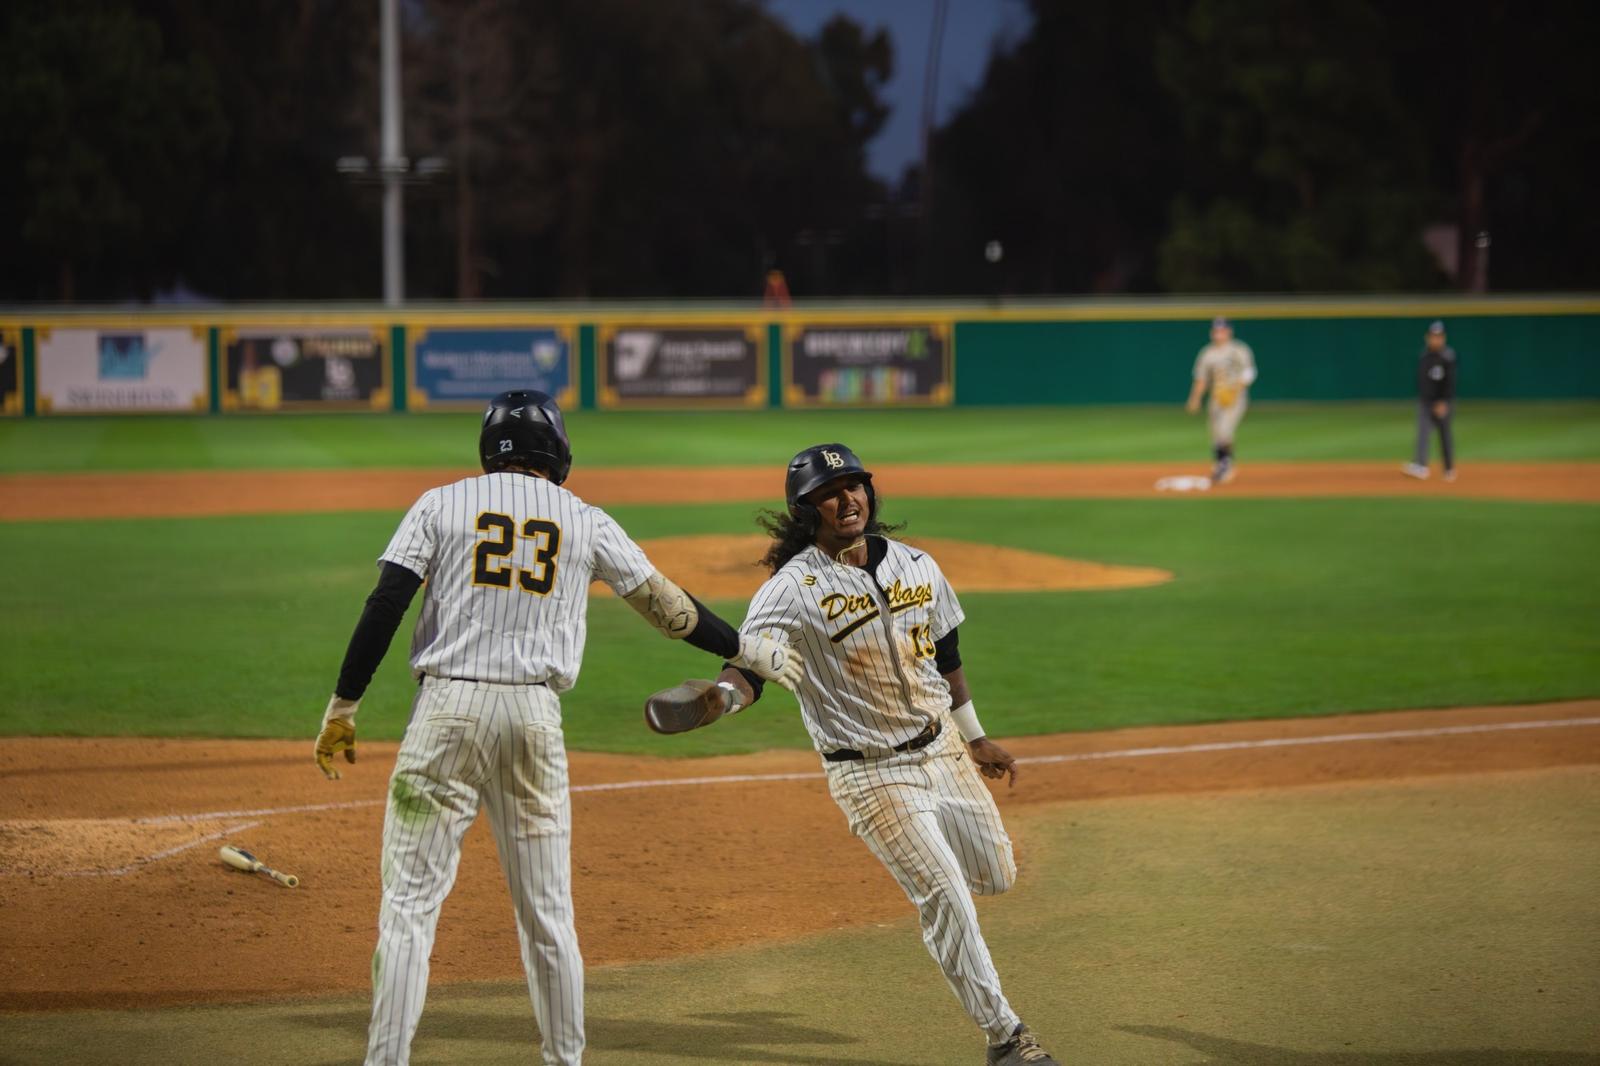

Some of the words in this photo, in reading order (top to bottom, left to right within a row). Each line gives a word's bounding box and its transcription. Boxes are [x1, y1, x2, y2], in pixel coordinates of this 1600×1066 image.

[499, 439, 513, 452] 23
[820, 450, 845, 470] LB
[473, 511, 562, 596] 23
[911, 623, 936, 658] 13
